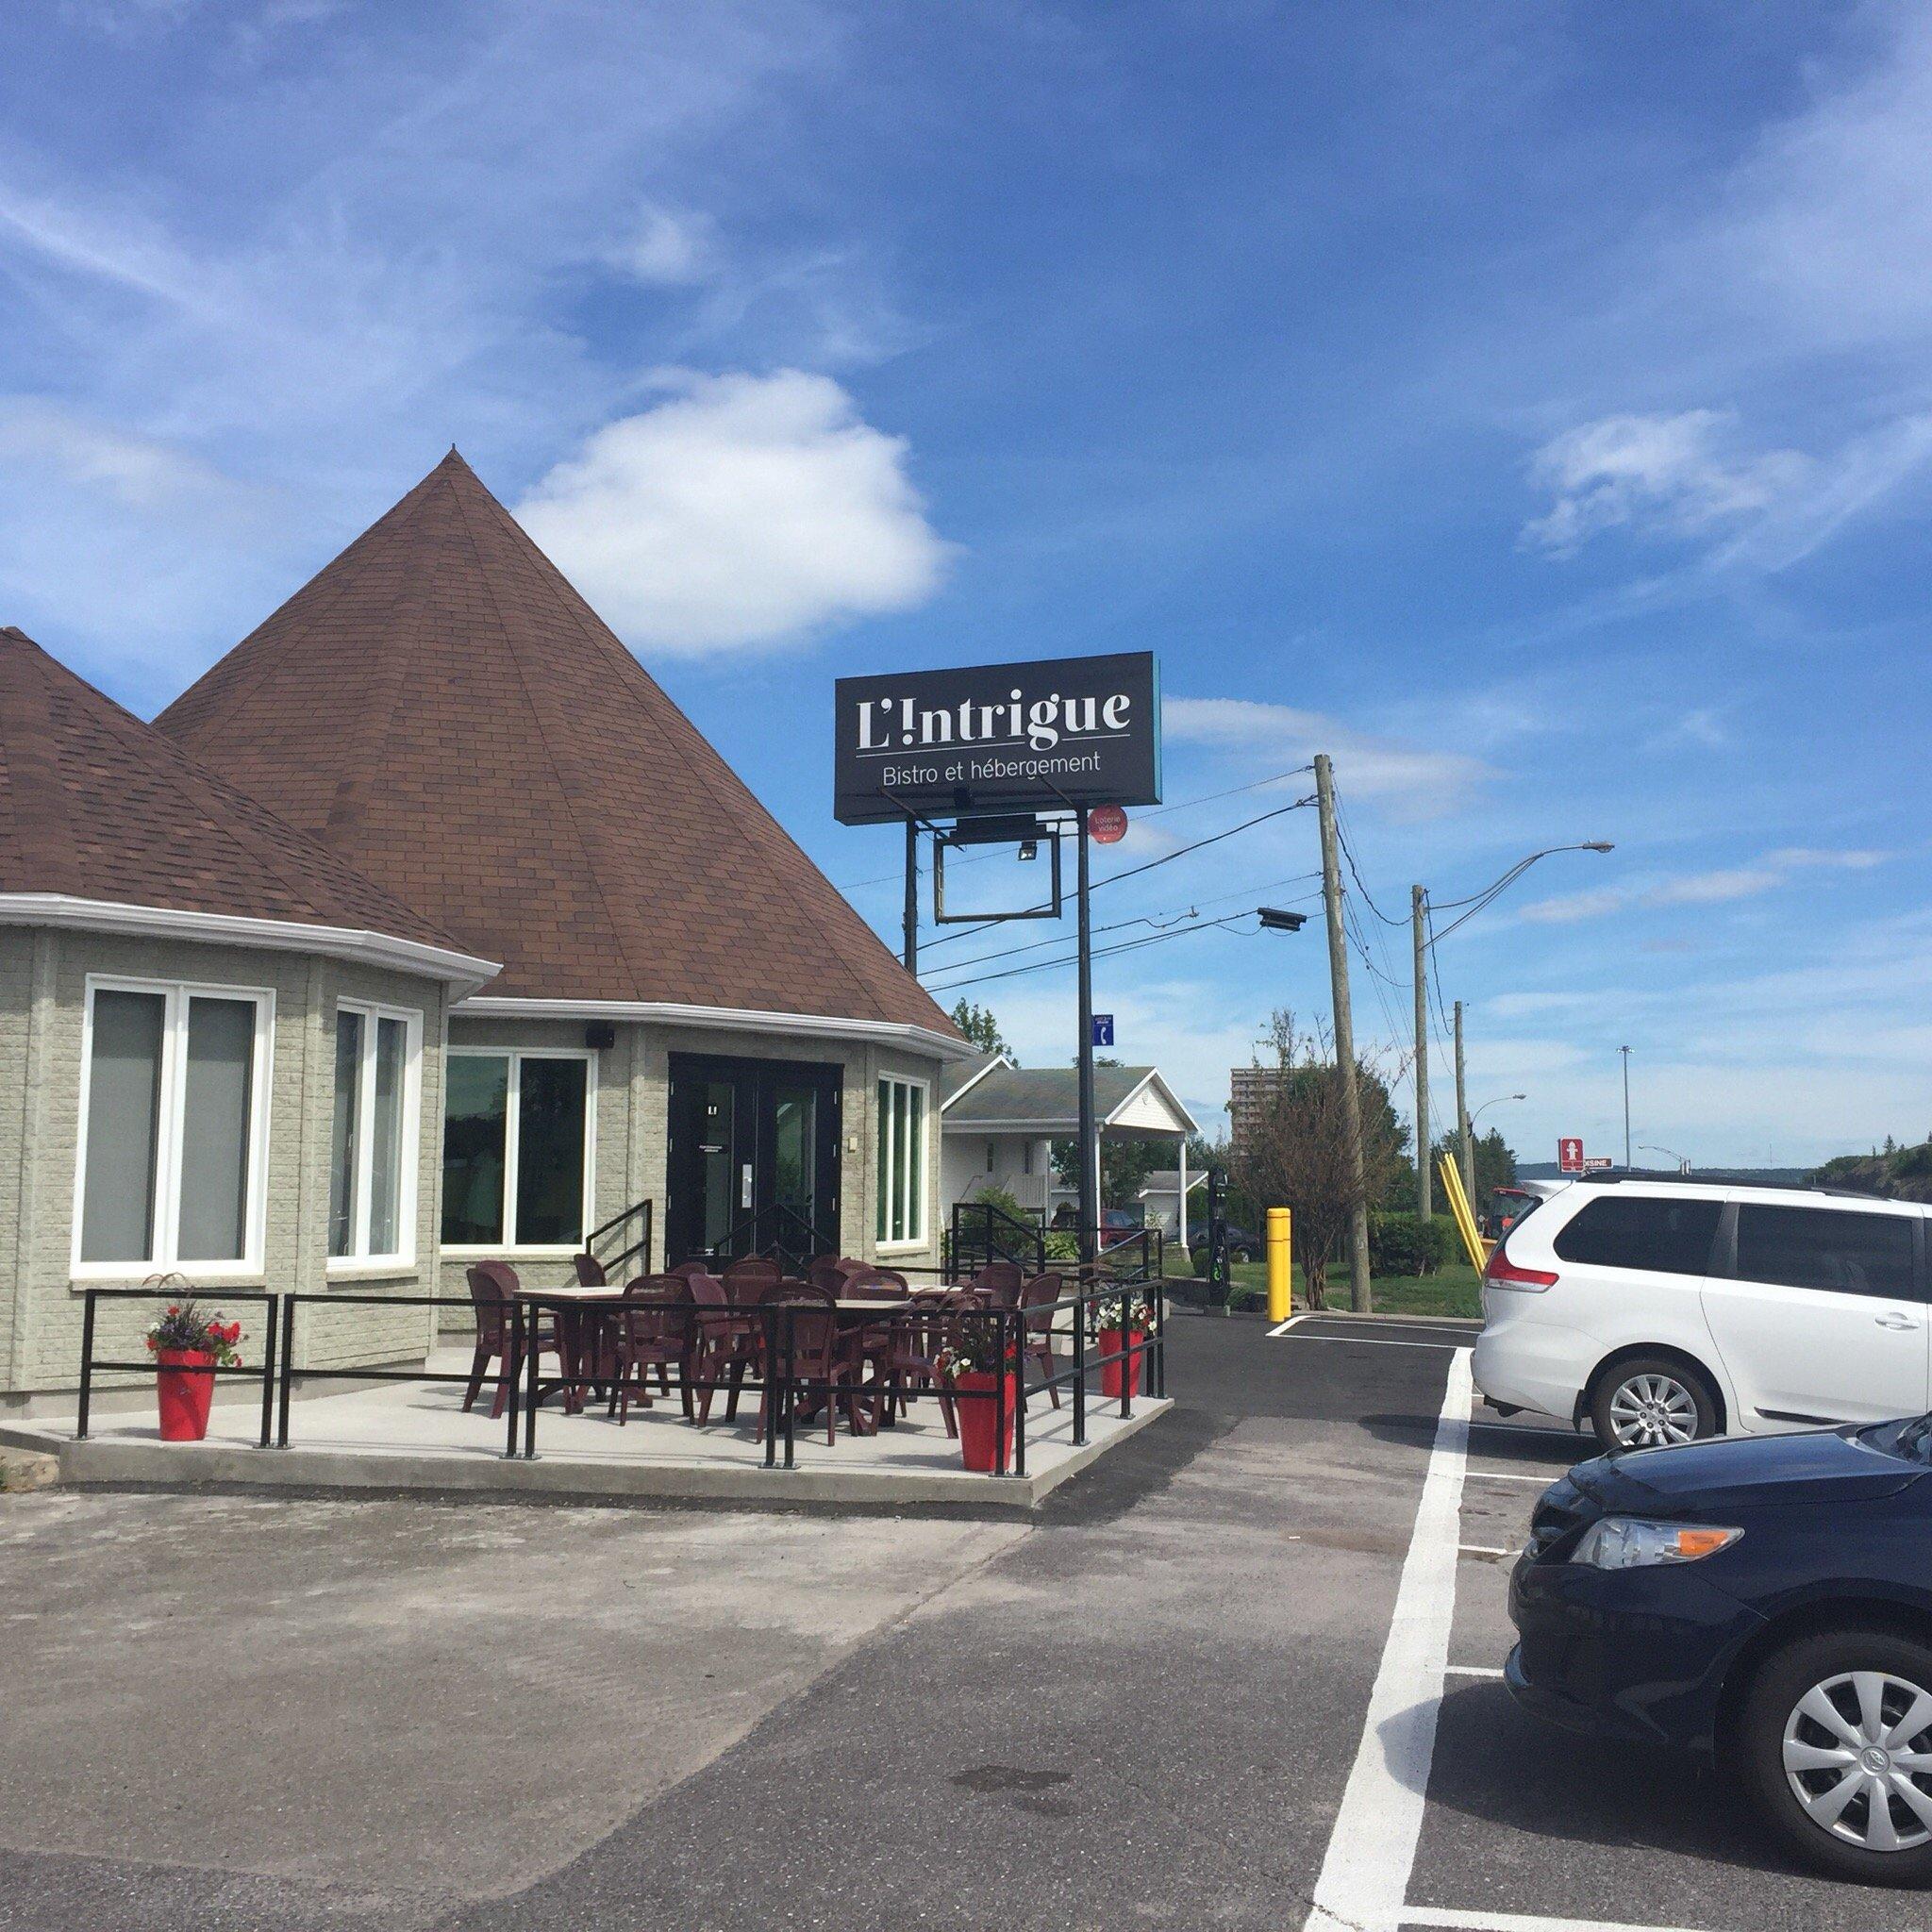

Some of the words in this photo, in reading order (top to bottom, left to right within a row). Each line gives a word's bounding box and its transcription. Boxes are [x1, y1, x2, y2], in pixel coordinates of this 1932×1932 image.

[883, 765, 938, 786] Bistro
[944, 761, 964, 781] et
[971, 751, 1101, 780] hébergement
[1094, 816, 1121, 824] Loterie
